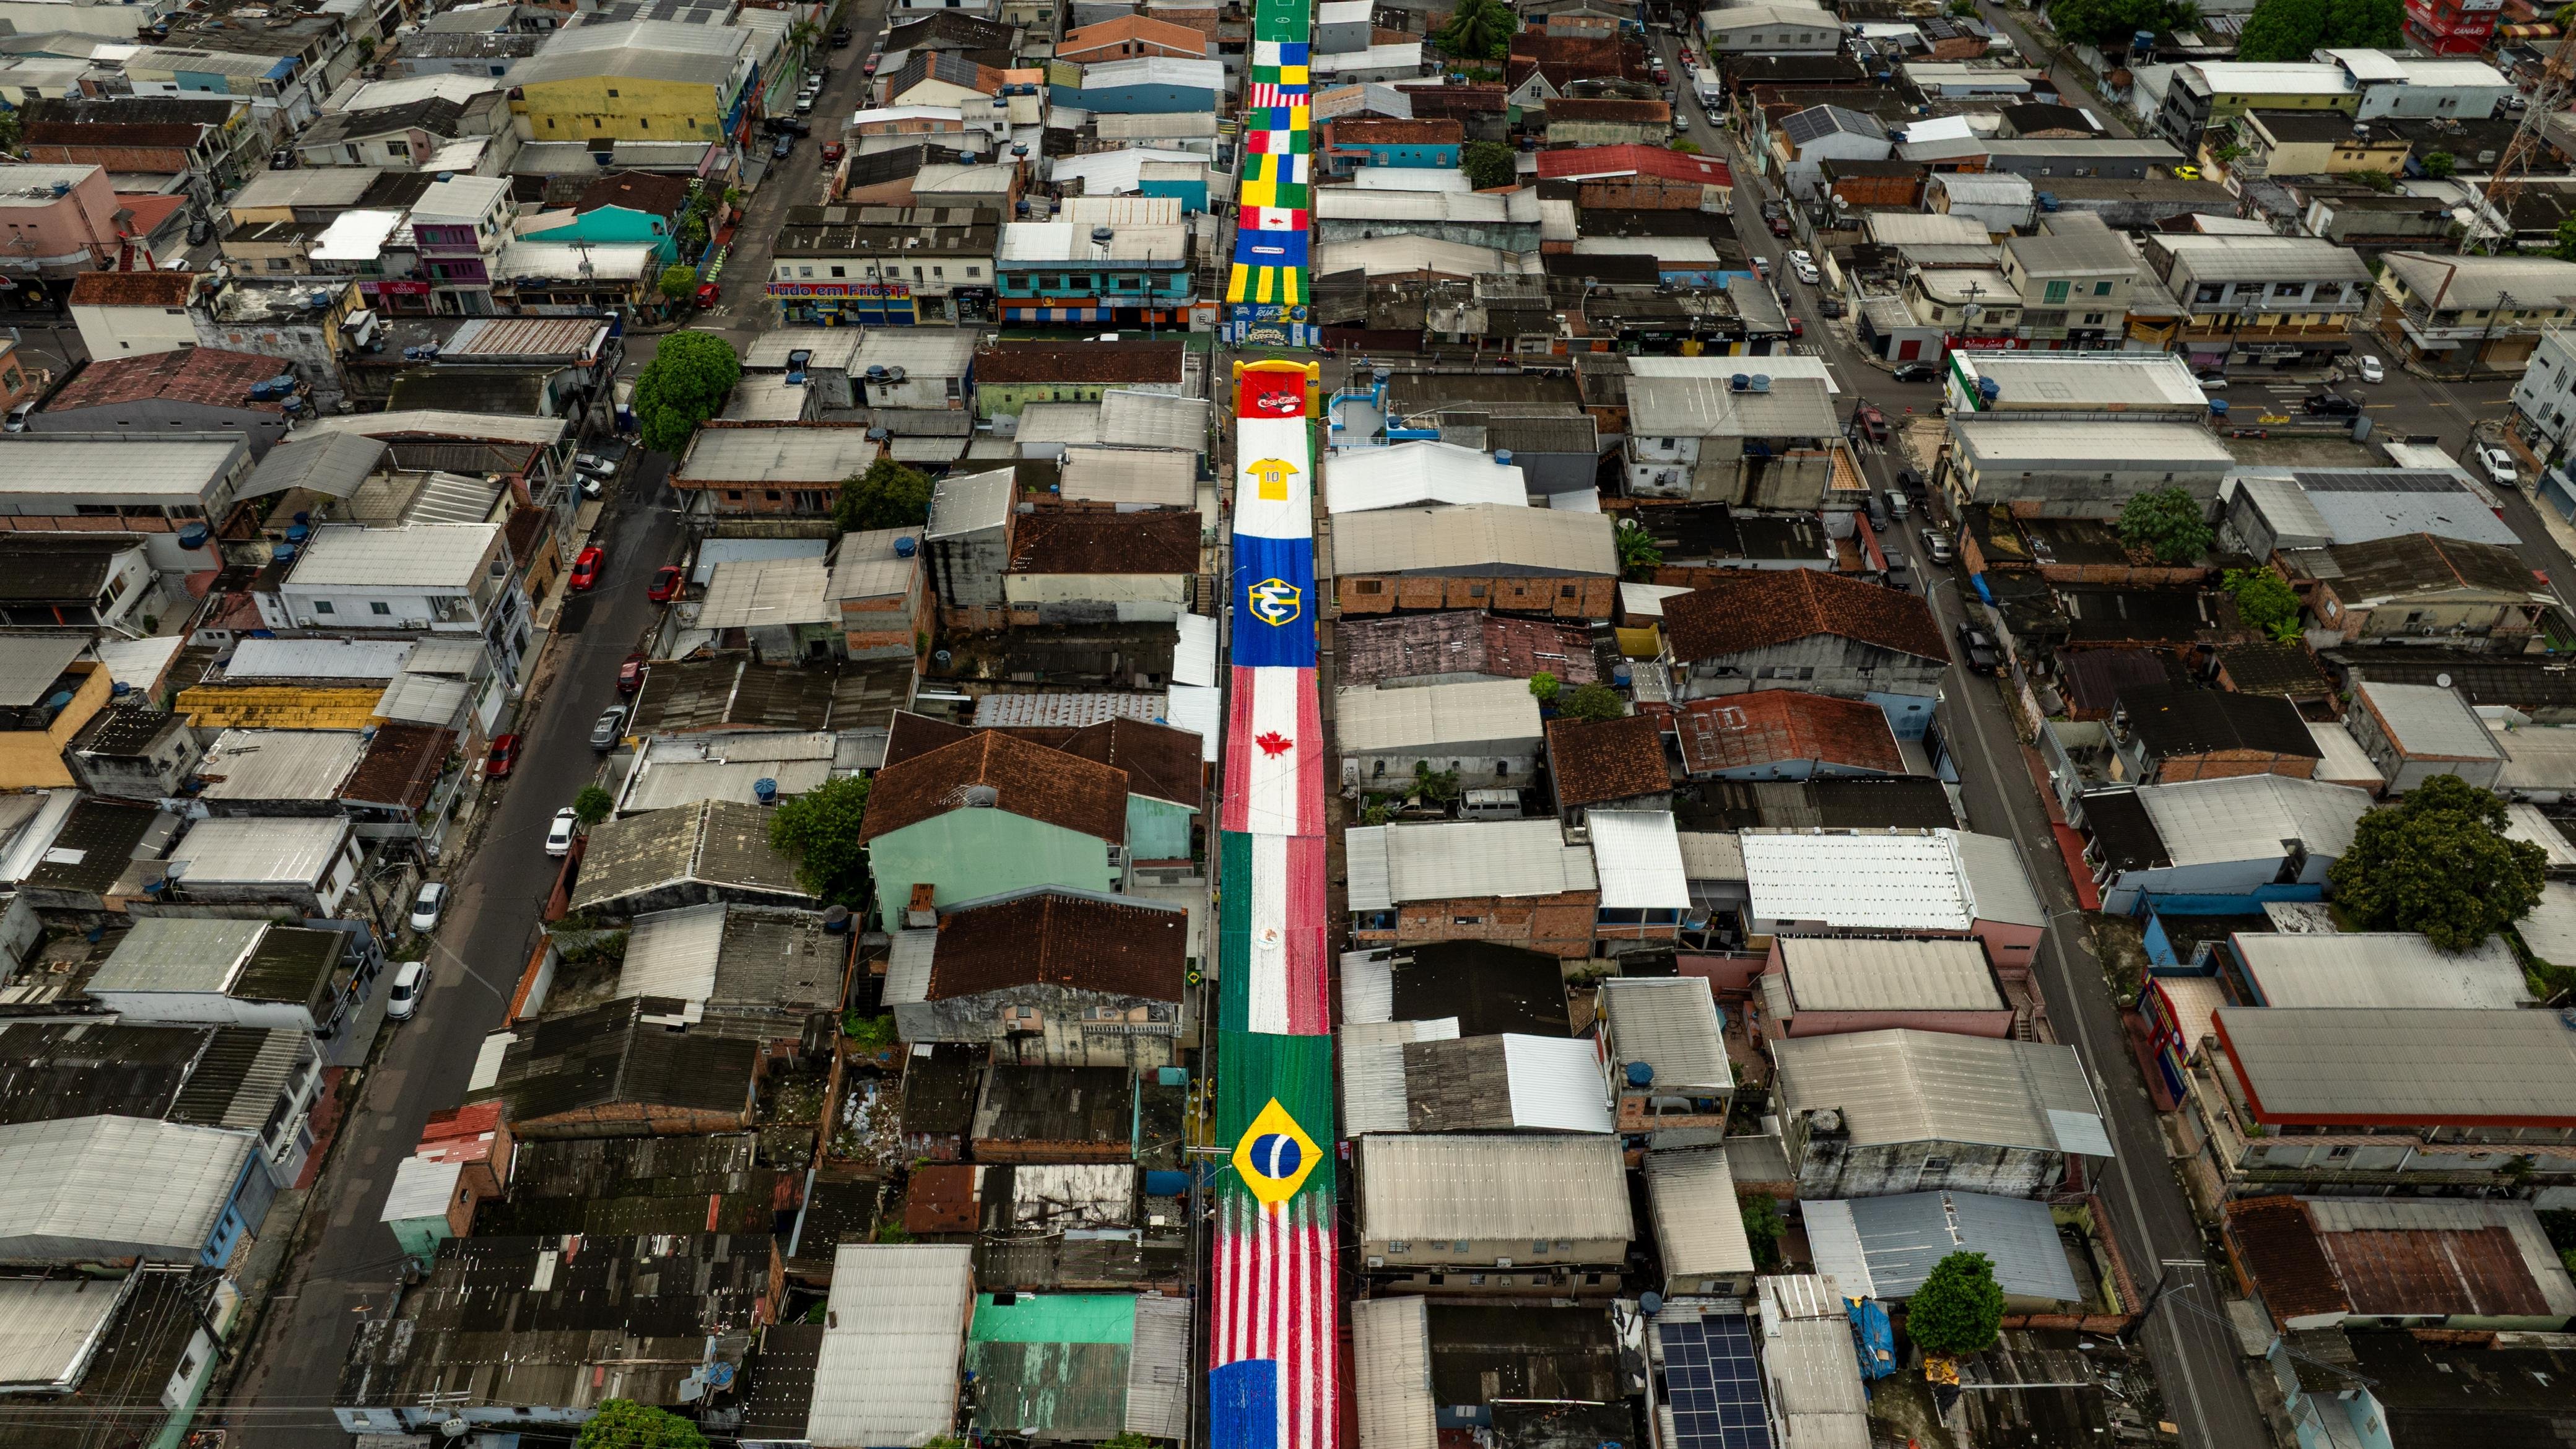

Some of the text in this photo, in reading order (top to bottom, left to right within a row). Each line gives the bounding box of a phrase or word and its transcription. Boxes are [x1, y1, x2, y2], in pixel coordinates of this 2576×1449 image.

[767, 284, 892, 297] Tudo em Frios
[1796, 344, 1825, 355] PARE
[1258, 399, 1277, 407] Coca
[1265, 471, 1279, 482] 10
